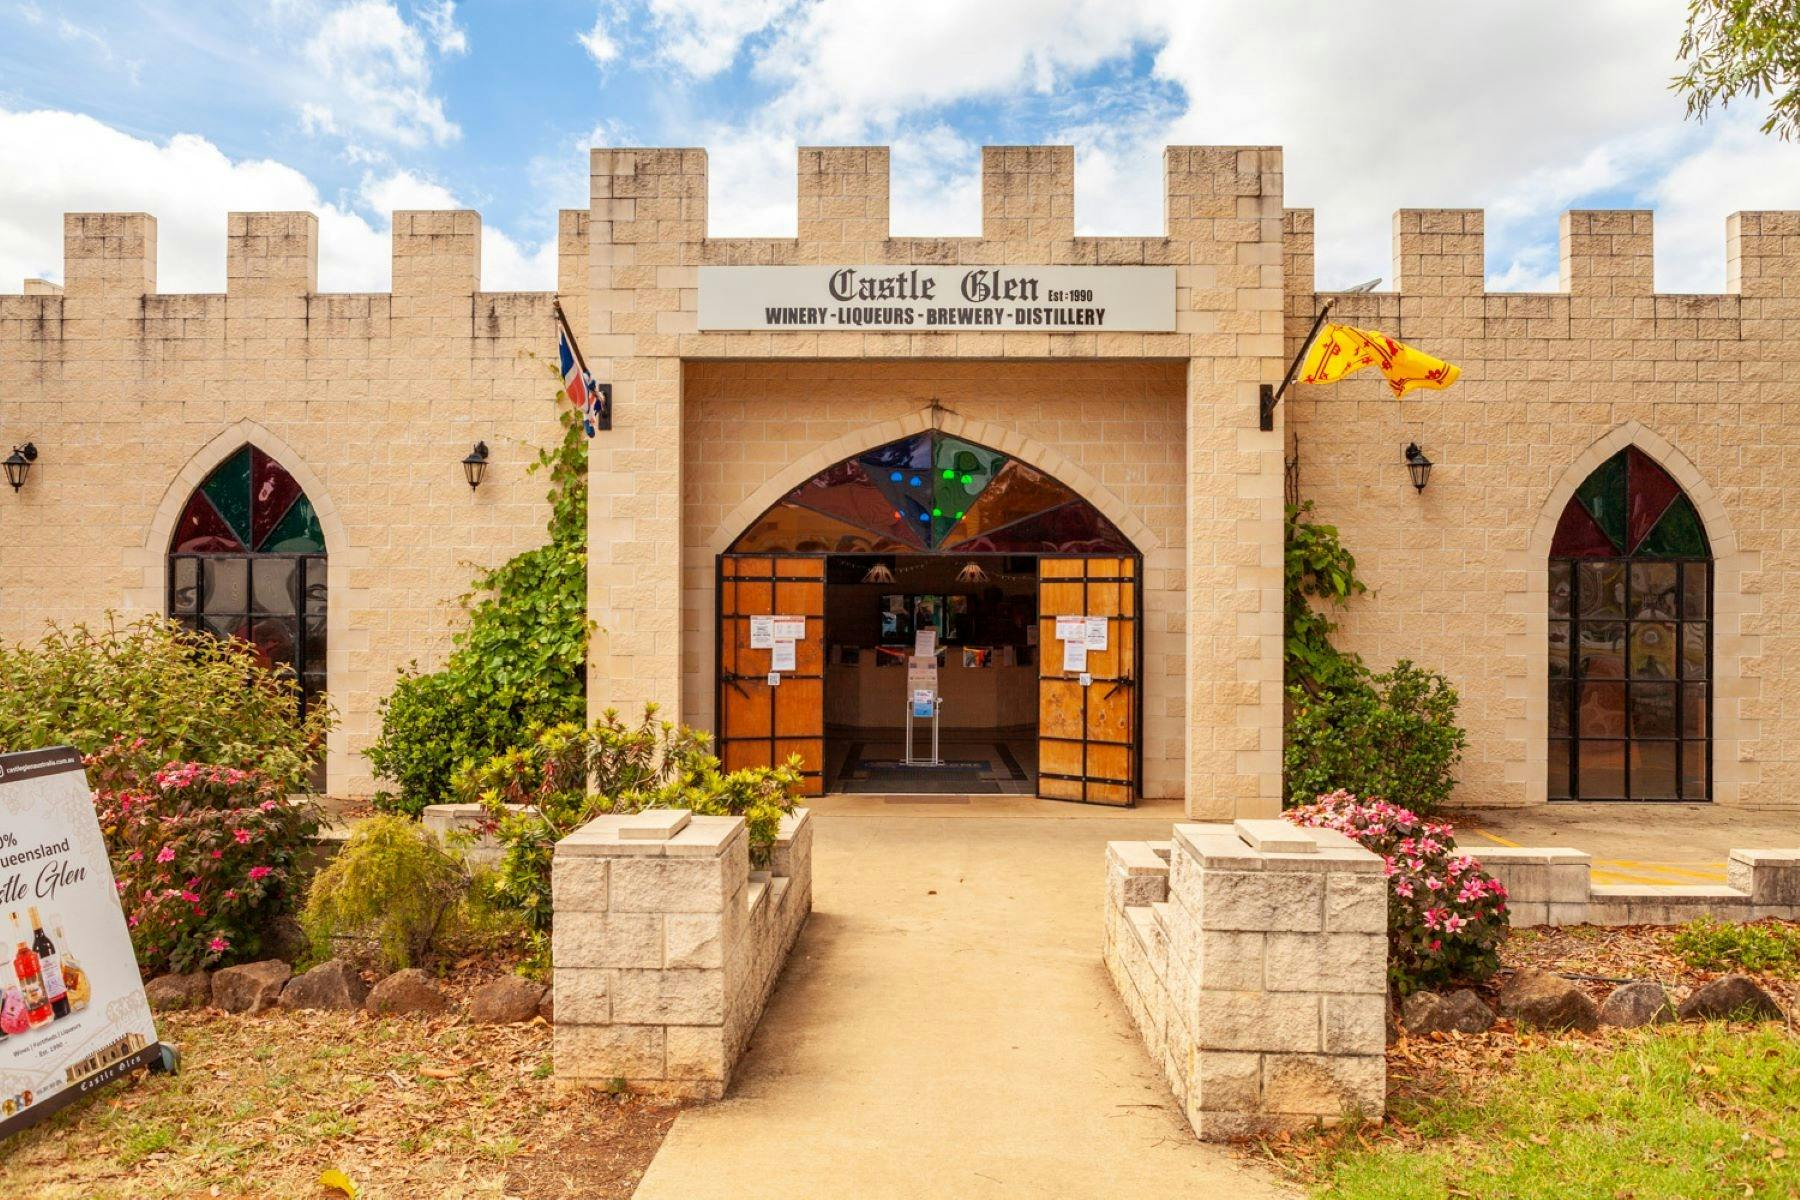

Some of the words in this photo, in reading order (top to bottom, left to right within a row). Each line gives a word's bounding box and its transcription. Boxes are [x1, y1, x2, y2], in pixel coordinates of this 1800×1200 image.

[829, 268, 936, 301] Castle
[961, 269, 1039, 302] Glen
[35, 859, 86, 900] Glen
[80, 1069, 114, 1091] Castle
